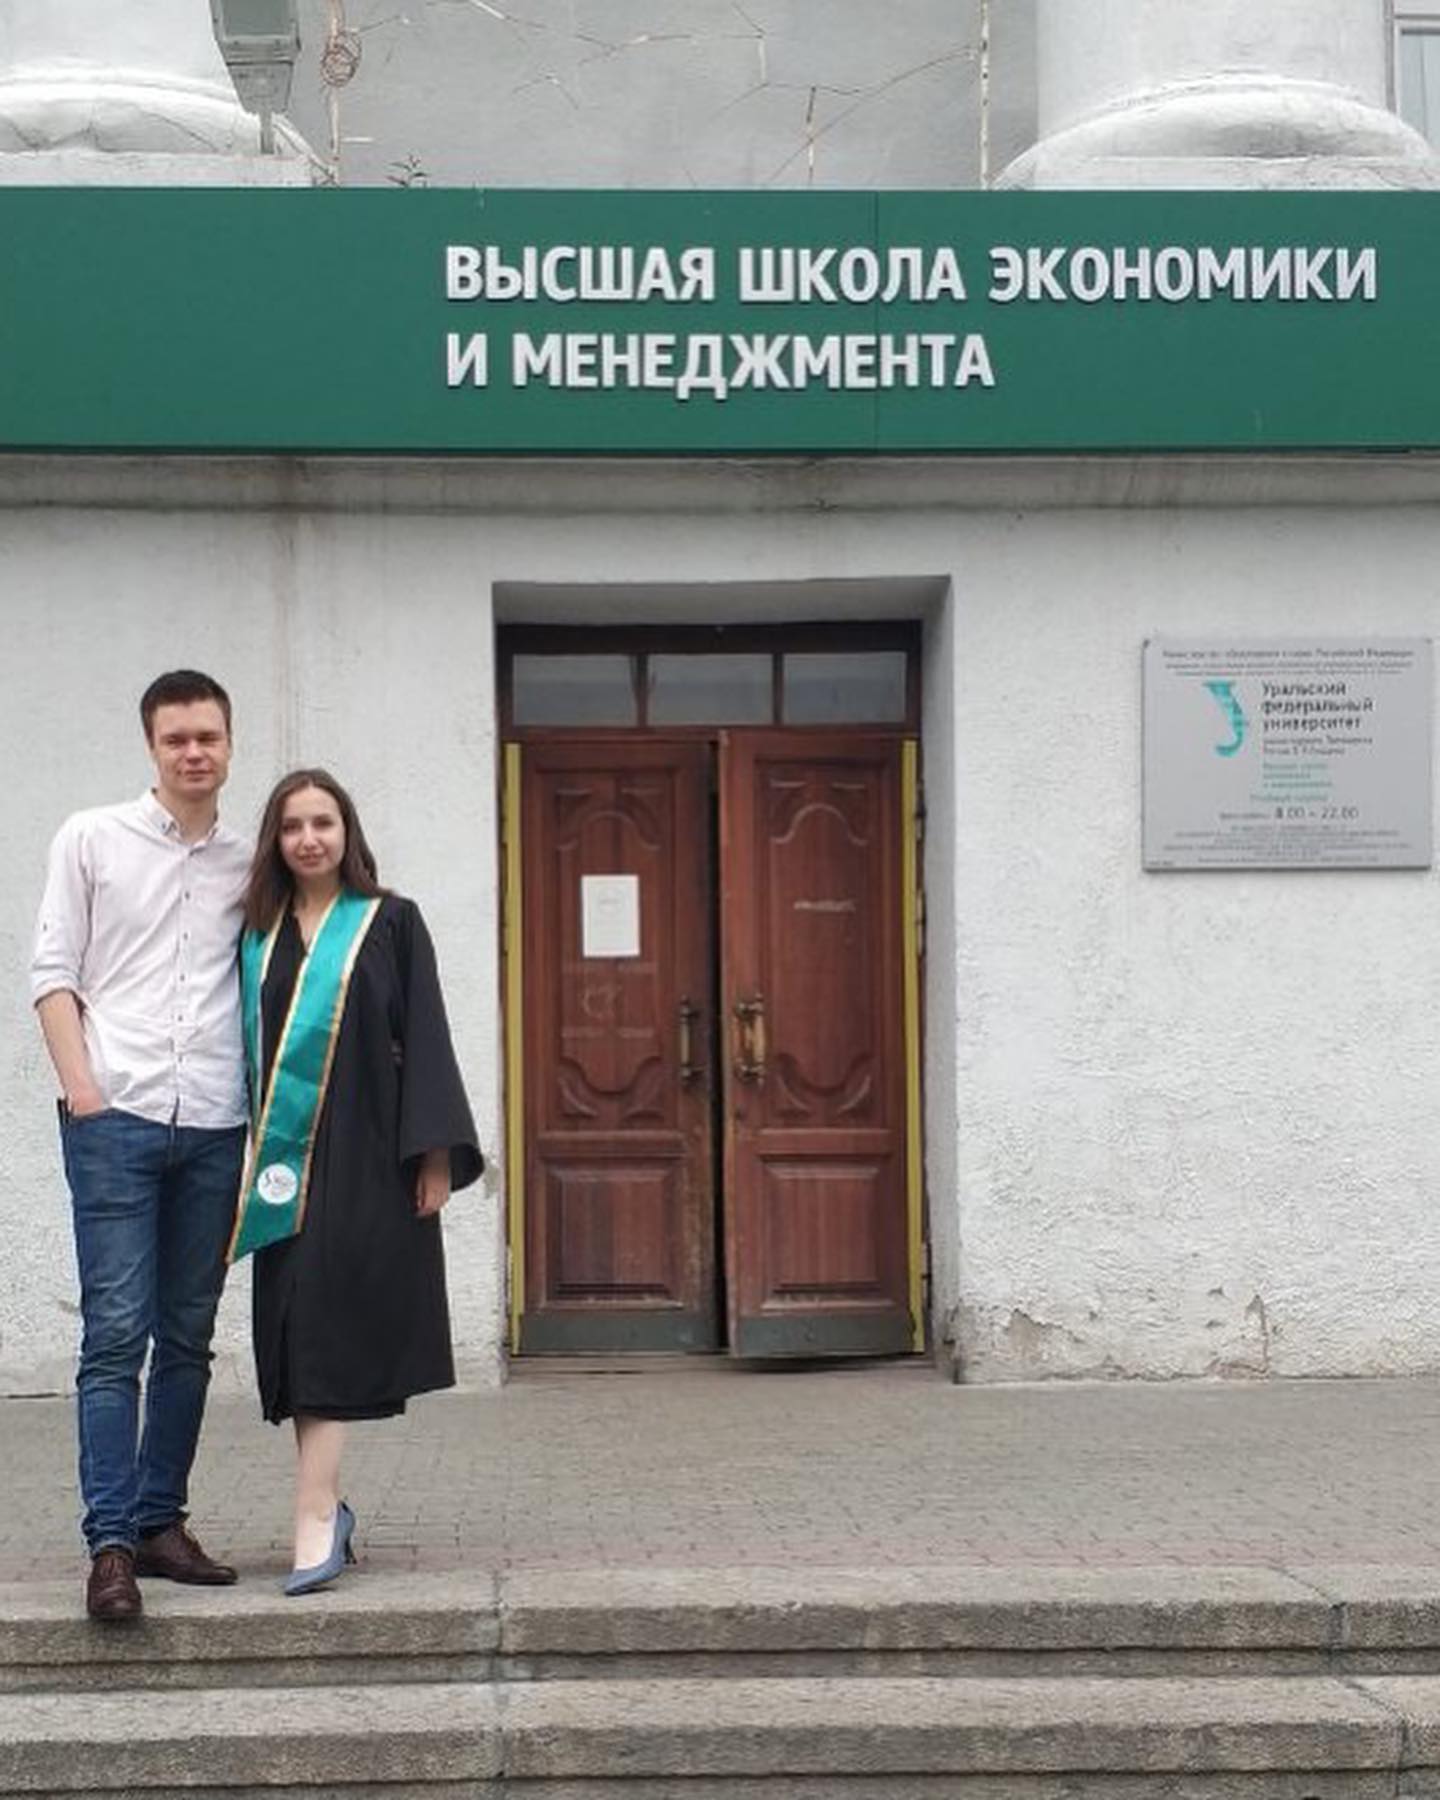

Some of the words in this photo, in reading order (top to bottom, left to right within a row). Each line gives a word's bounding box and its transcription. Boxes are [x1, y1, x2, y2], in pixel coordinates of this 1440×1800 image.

[445, 245, 715, 302] ВЫСШАЯ
[738, 246, 966, 303] ШКОЛА
[988, 246, 1377, 303] ЭКОНОМИКИ
[446, 332, 488, 388] И
[512, 332, 995, 400] МЕНЕДЖМЕНТА
[1262, 681, 1346, 698] Уральский
[1261, 697, 1373, 716] федеральный
[1263, 718, 1361, 732] университет
